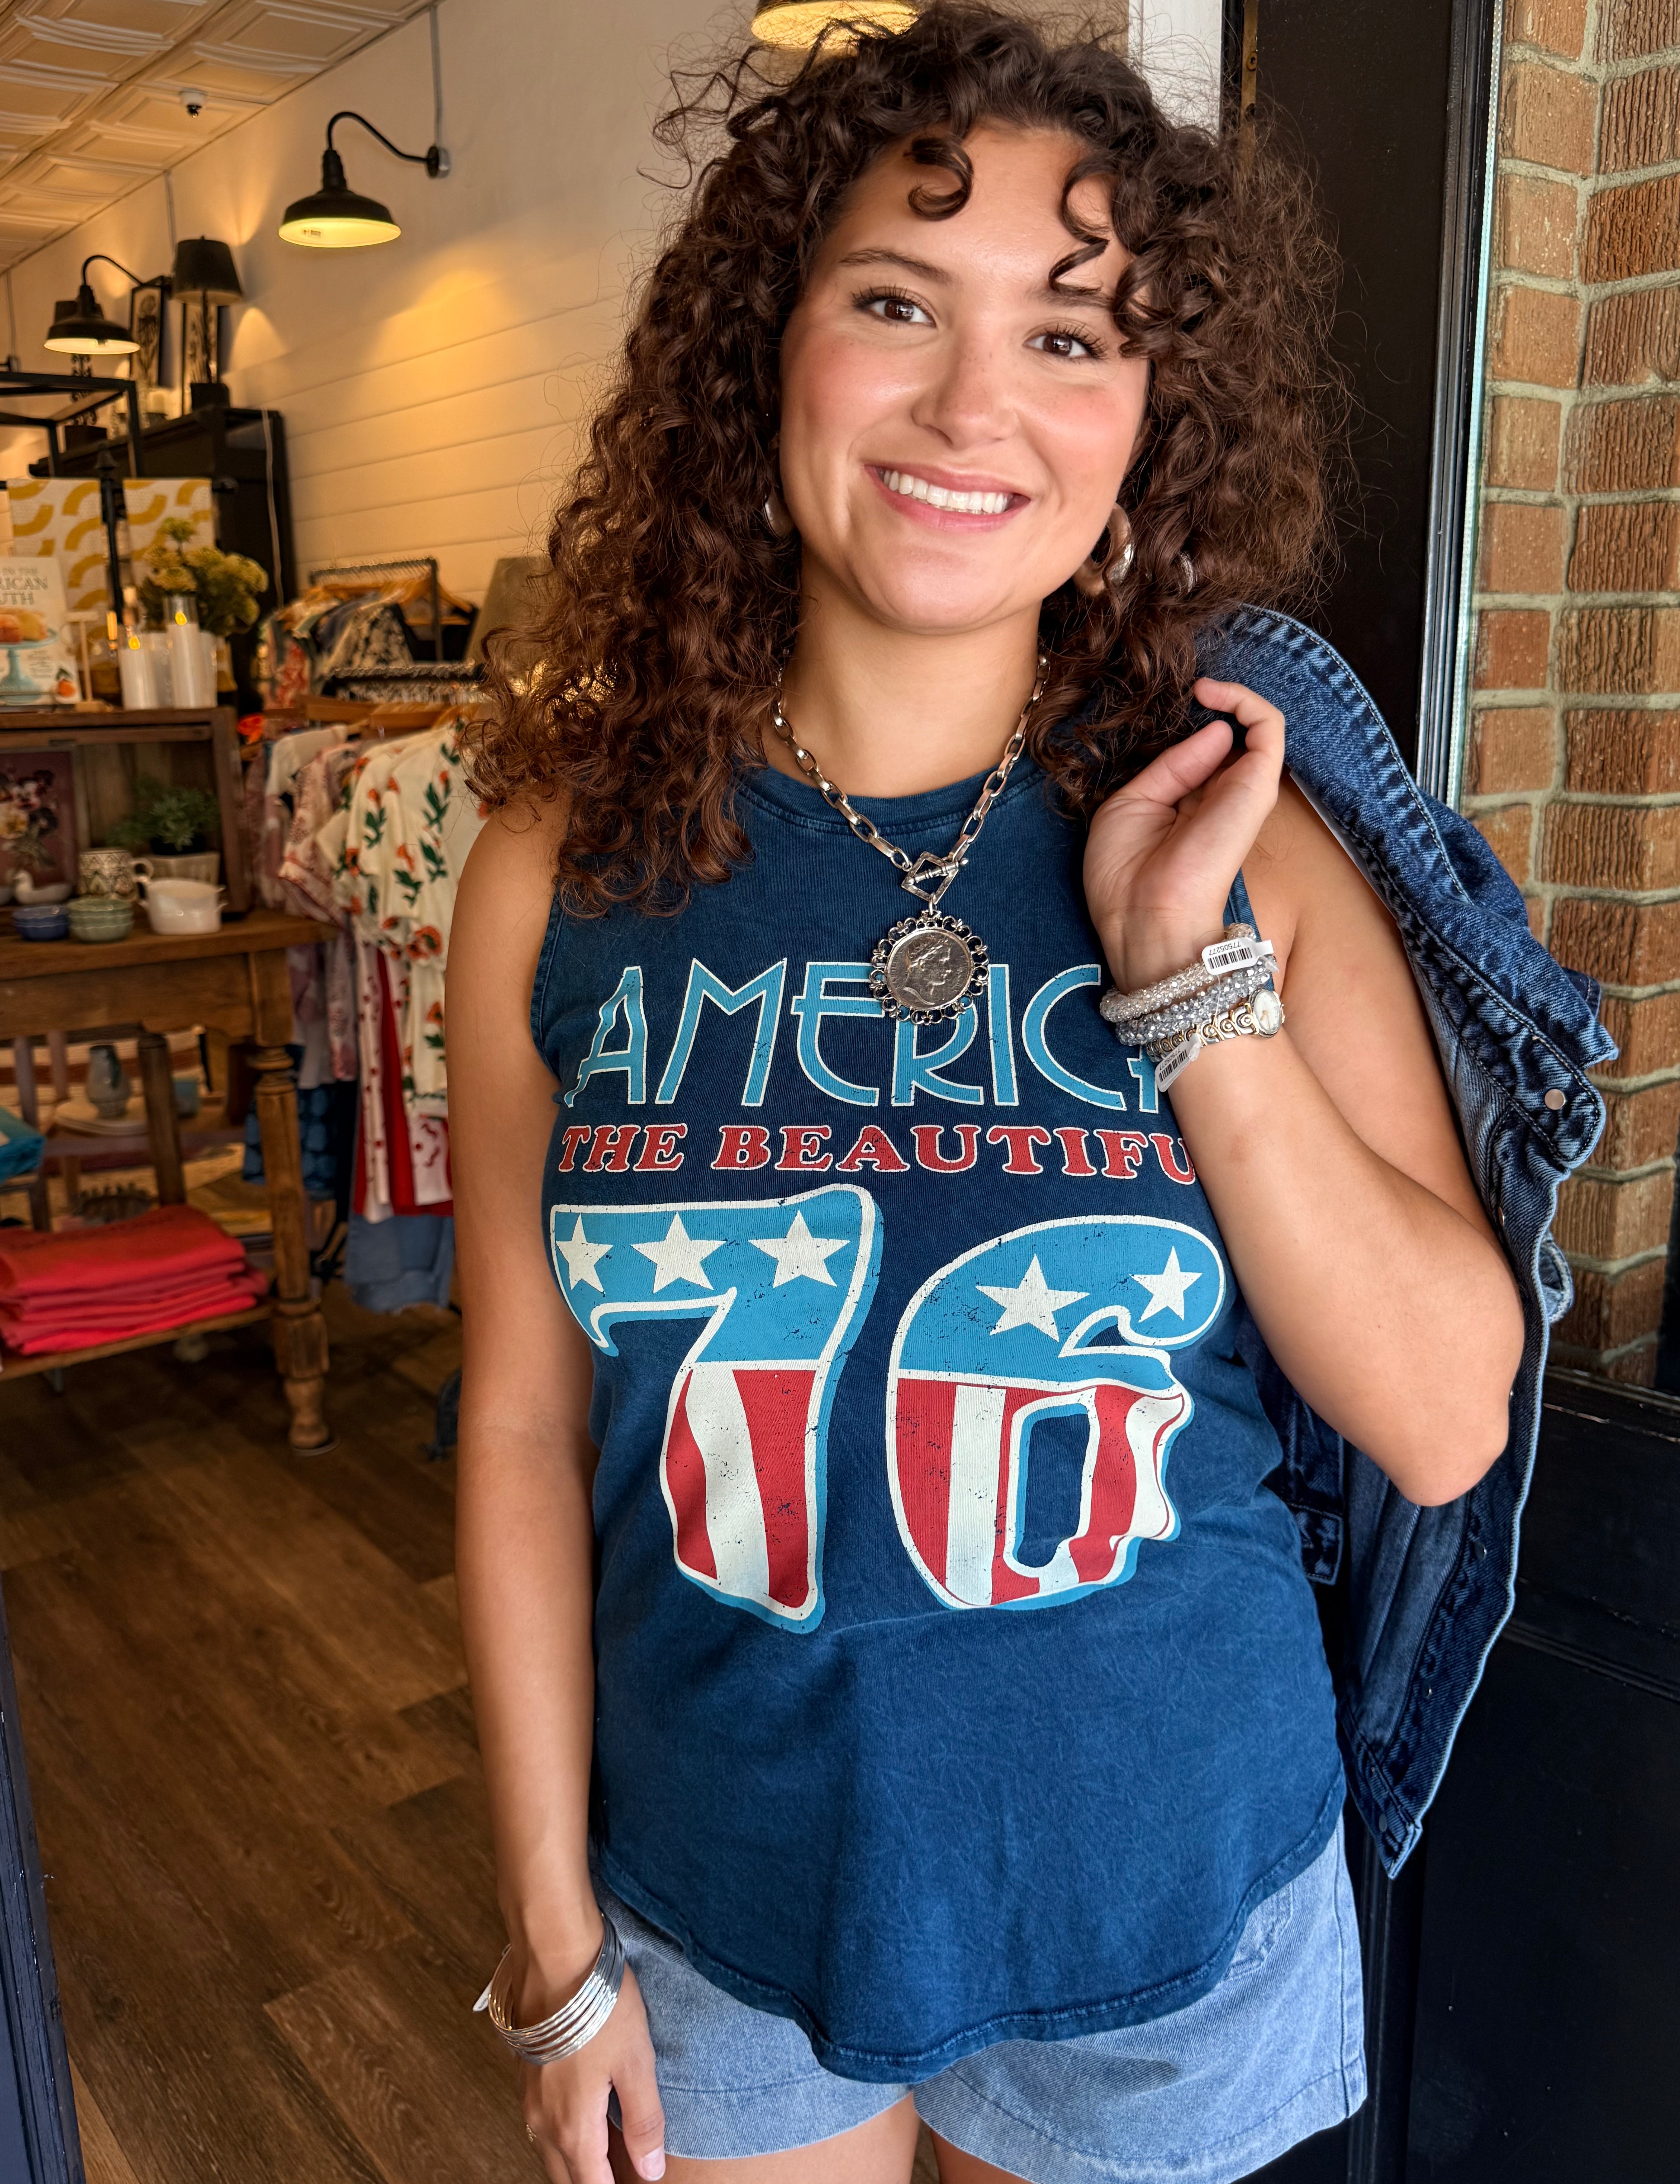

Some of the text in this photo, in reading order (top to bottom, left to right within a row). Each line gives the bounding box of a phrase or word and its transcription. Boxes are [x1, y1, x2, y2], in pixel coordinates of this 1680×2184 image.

[1209, 941, 1241, 955] 77505277
[558, 1123, 688, 1172] THE
[550, 1183, 1227, 1634] 76
